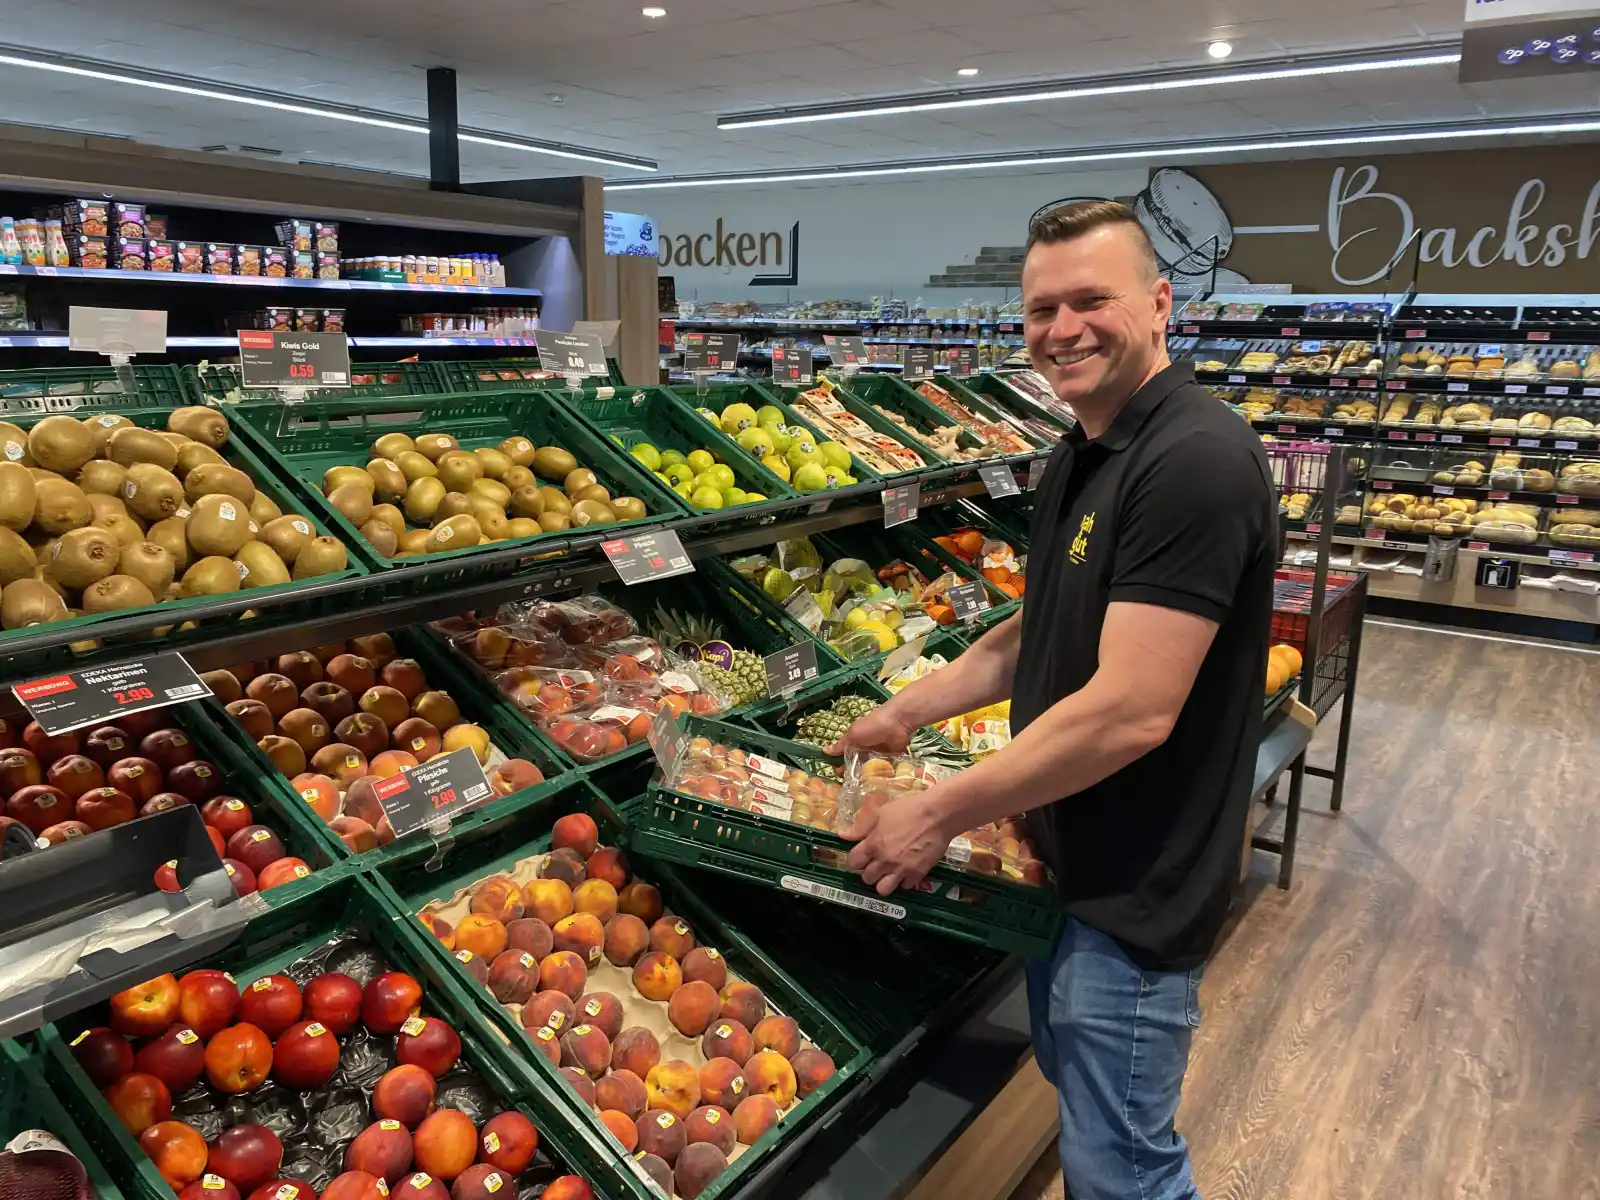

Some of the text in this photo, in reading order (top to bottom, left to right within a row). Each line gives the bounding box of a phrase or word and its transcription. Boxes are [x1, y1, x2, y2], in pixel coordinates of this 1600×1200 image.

[280, 341, 320, 350] Kiwis Gold
[568, 356, 585, 368] 0.49
[289, 364, 315, 378] 0.59
[80, 668, 107, 679] EDEKA
[85, 667, 148, 686] Nektarinen
[788, 667, 801, 682] 3.49
[112, 687, 155, 705] 2.99
[417, 766, 449, 784] Pfirsiche
[431, 788, 457, 809] 2.99
[891, 907, 904, 916] 106
